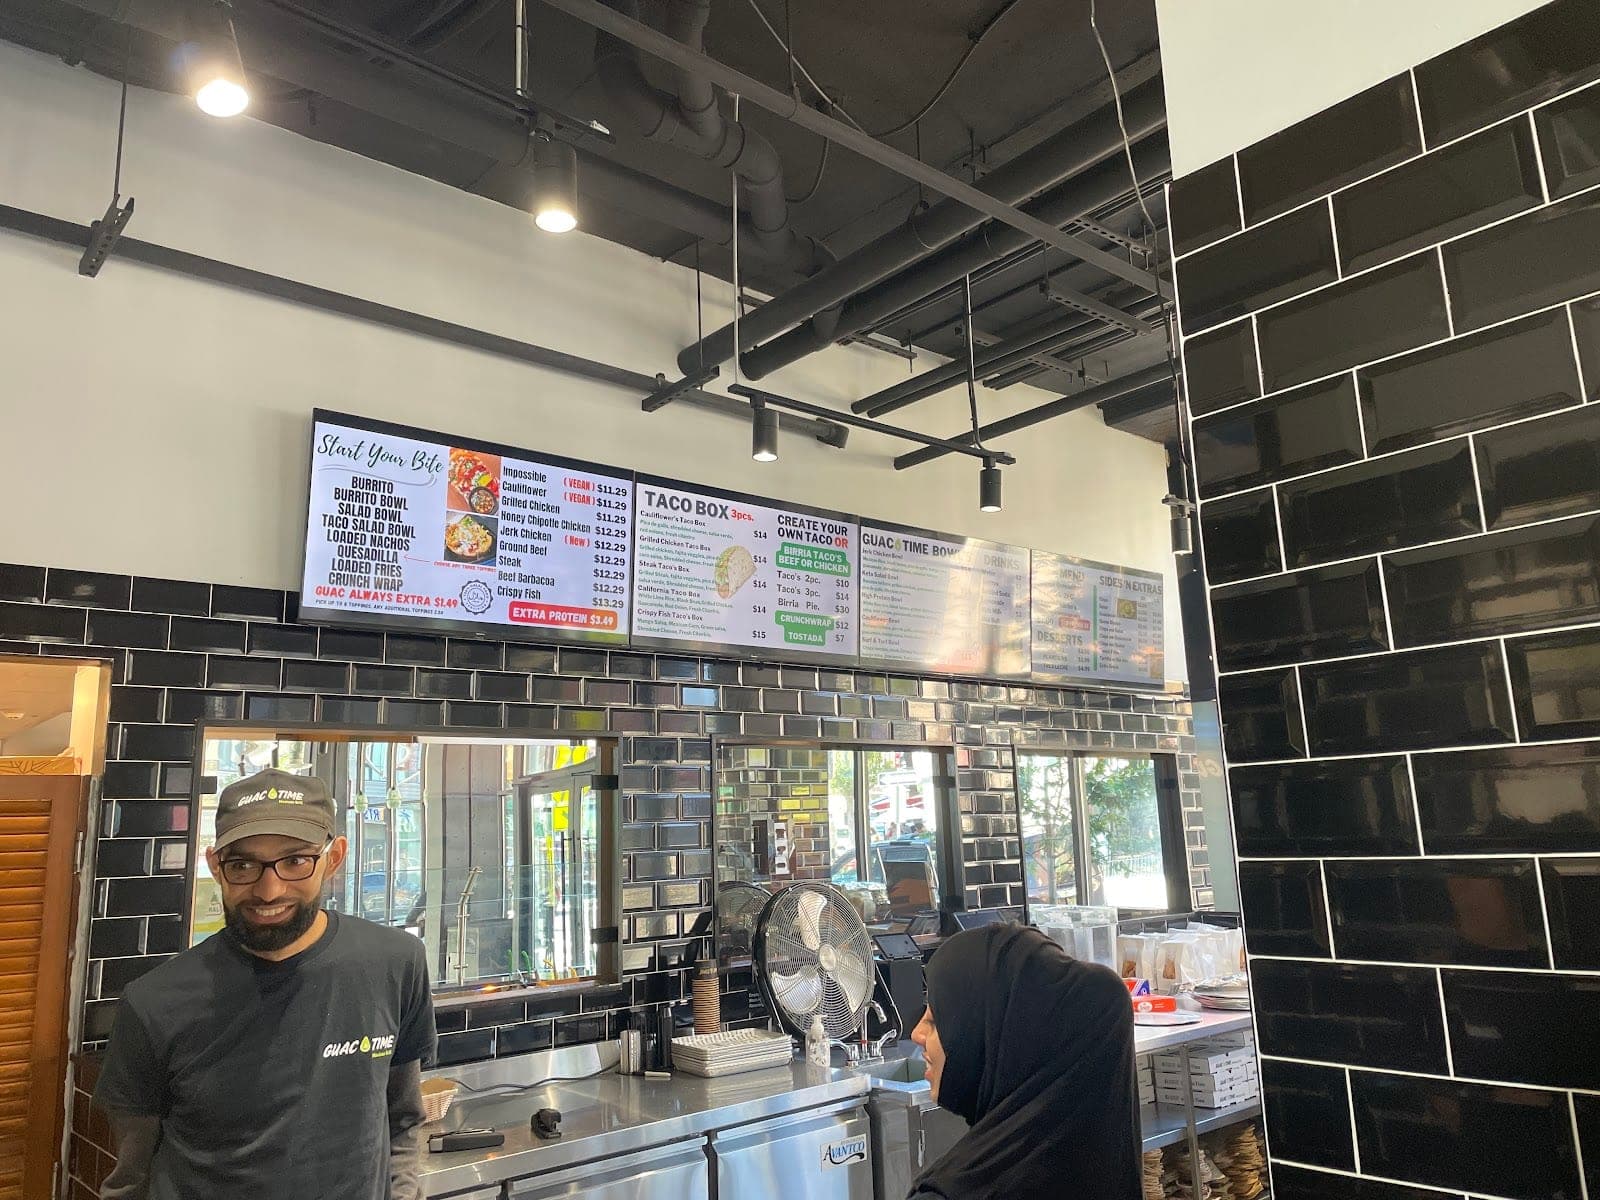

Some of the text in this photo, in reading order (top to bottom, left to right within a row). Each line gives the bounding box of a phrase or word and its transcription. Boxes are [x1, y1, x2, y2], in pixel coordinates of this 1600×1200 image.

[317, 434, 443, 473] Start Your Bite
[351, 476, 394, 494] BURRITO
[503, 465, 547, 483] Impossible
[334, 488, 408, 510] BURRITO BOWL
[502, 480, 547, 497] Cauliflower
[597, 484, 627, 496] $11.29
[338, 503, 403, 523] SALAD BOWL
[501, 495, 626, 524] Grilled Chicken $11.29
[596, 498, 627, 510] $11.29
[644, 490, 754, 522] TACO BOX 3pcs.
[322, 514, 416, 538] TACO SALAD BOWL
[501, 510, 626, 538] Honey Chipotle Chicken $12.29
[640, 510, 767, 539] Cauliflower's Taco Box $14
[777, 514, 848, 536] CREATE YOUR
[327, 529, 410, 551] LOADED NACHOS
[500, 526, 518, 537] Jerk
[520, 529, 552, 542] Chicken
[594, 540, 626, 552] $12.29
[777, 527, 848, 548] OWN TACO OR
[862, 533, 895, 549] GUAC
[902, 539, 929, 555] TIME
[337, 545, 398, 563] QUESADILLA
[499, 541, 528, 553] Ground
[530, 544, 547, 556] Beef
[594, 554, 625, 566] $12.29
[640, 535, 660, 544] Grilled
[660, 538, 684, 547] Chicken
[753, 555, 767, 564] $14
[784, 546, 842, 563] BIRRIA TACO'S
[332, 558, 402, 577] LOADED FRIES
[498, 555, 625, 580] Steak $12.29
[778, 555, 848, 573] BEEF OR CHICKEN
[983, 554, 1021, 571] DRINKS
[328, 572, 403, 592] CRUNCH WRAP
[498, 570, 624, 595] Beef Barbacoa $12.29
[639, 559, 767, 589] Steak Taco's Box $14
[777, 570, 850, 588] Taco's 2pc. $10
[315, 586, 458, 608] GUAC ALWAYS EXTRA $1.49
[497, 585, 523, 599] Crispy
[525, 588, 541, 601] Fish
[592, 597, 624, 609] $13.29
[777, 583, 849, 601] Taco's 3pc. $14
[1099, 576, 1123, 589] SIDES
[1132, 582, 1162, 596] EXTRAS
[637, 585, 669, 594] California
[671, 588, 687, 596] Taco
[752, 605, 766, 614] $14
[778, 598, 799, 608] Birria
[834, 605, 850, 614] $30
[512, 607, 614, 626] EXTRA PROTEIN $3.49
[637, 609, 657, 618] Crispy
[659, 610, 671, 618] Fish
[672, 612, 691, 620] Taco's
[752, 631, 766, 639] $15
[780, 614, 849, 630] CRUNCHWRAP $12
[788, 632, 845, 642] TOSTADA $7
[238, 790, 304, 807] GUAC TIME
[323, 1040, 360, 1058] GUAC
[371, 1035, 395, 1051] TIME
[823, 1141, 865, 1164] AVANTCO
